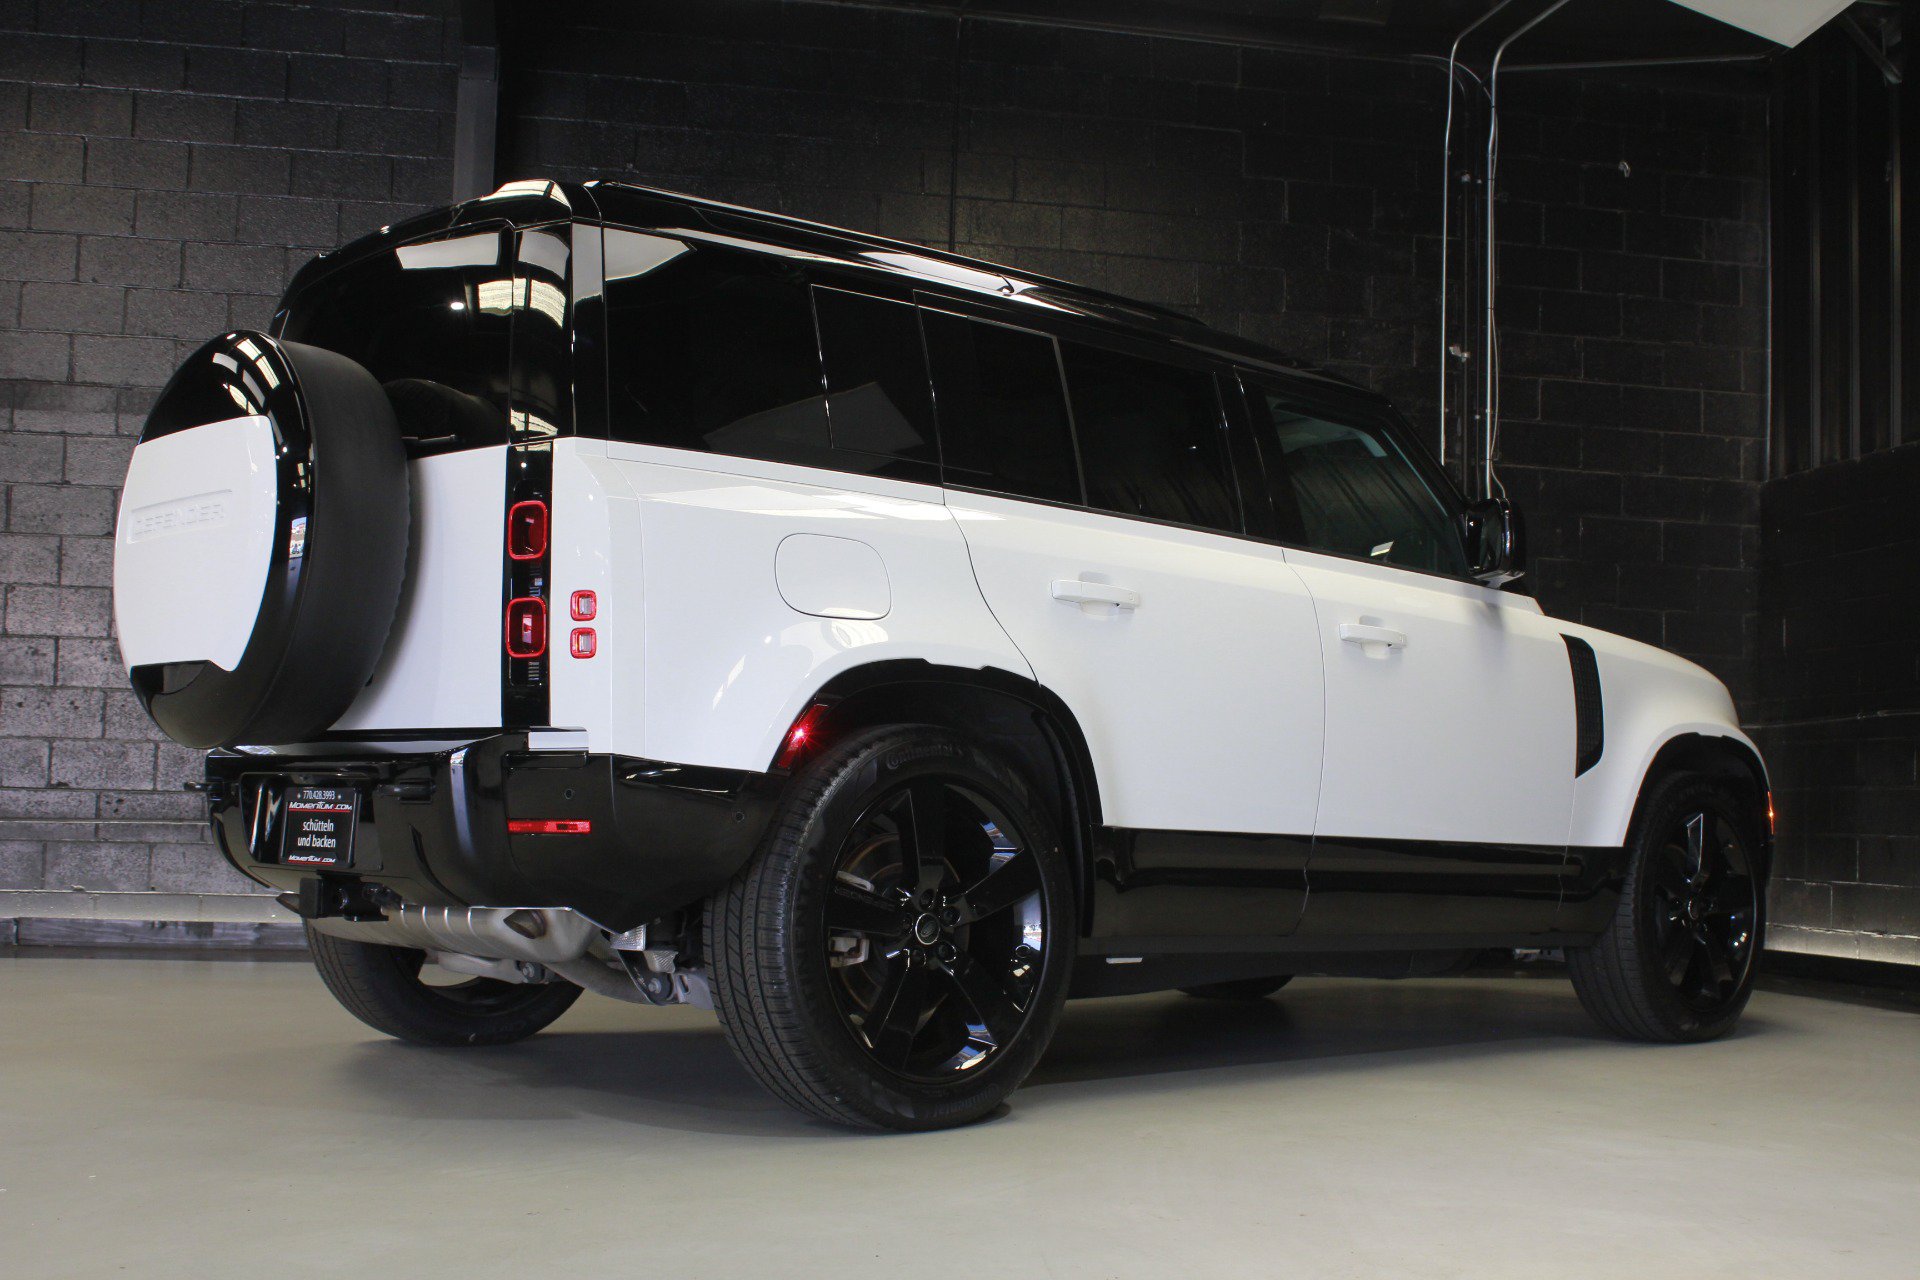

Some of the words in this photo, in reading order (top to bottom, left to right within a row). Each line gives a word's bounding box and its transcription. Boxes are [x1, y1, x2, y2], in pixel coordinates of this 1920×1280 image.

[303, 818, 334, 832] schütteln
[297, 834, 311, 847] und
[312, 835, 336, 848] backen
